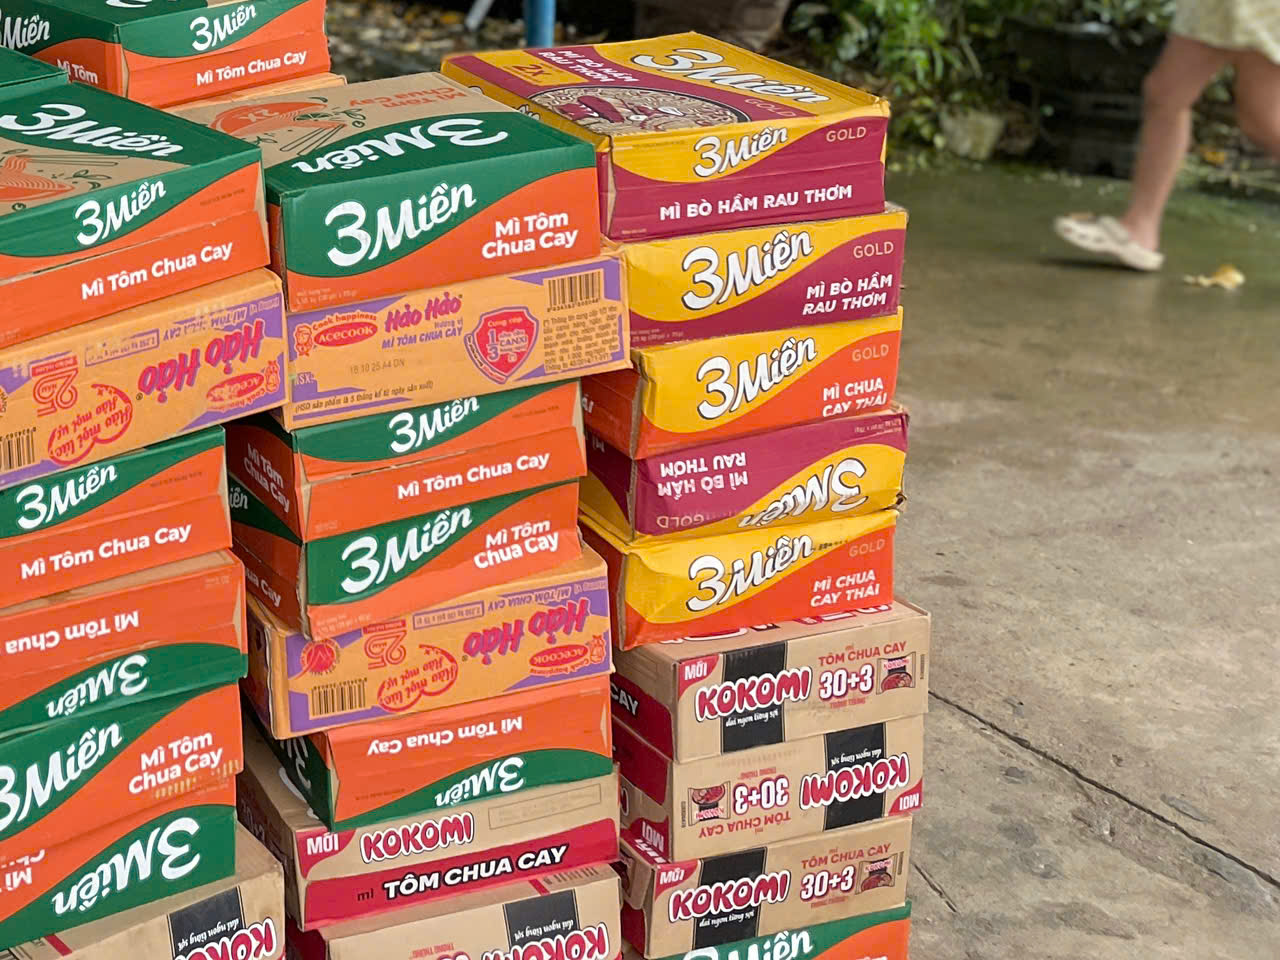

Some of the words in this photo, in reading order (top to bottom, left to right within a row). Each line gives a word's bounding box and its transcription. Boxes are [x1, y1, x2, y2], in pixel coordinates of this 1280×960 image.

[196, 70, 215, 86] Mì
[216, 66, 246, 82] Tôm
[248, 59, 281, 75] Chua
[283, 50, 308, 70] Cay
[825, 125, 867, 143] GOLD
[660, 201, 680, 221] MÌ
[686, 198, 713, 217] BÒ
[763, 190, 800, 210] RAU
[804, 184, 854, 205] THƠM
[494, 221, 522, 240] Mì
[524, 213, 570, 235] Tôm
[481, 234, 536, 260] Chua
[537, 228, 580, 253] Cay
[852, 242, 895, 259] GOLD
[81, 278, 105, 300] Mì
[107, 270, 149, 291] Tôm
[150, 252, 198, 278] Chua
[199, 242, 234, 263] Cay
[806, 282, 826, 300] MÌ
[829, 276, 854, 297] BÒ
[802, 299, 838, 316] RAU
[841, 292, 888, 311] THƠM
[852, 343, 890, 362] GOLD
[822, 382, 842, 401] MÌ
[844, 377, 885, 398] CHUA
[822, 401, 853, 419] CAY
[855, 393, 888, 412] THÁI
[659, 455, 709, 478] THƠM
[714, 451, 747, 471] RAU
[397, 481, 421, 500] Mì
[423, 473, 463, 493] Tôm
[466, 464, 513, 483] Chua
[516, 452, 551, 471] Cay
[701, 474, 725, 494] BÒ
[728, 471, 749, 492] MÌ
[484, 529, 508, 549] Mì
[510, 520, 551, 541] Tôm
[20, 559, 47, 581] Mì
[49, 548, 95, 572] Tôm
[98, 535, 151, 559] Chua
[153, 524, 193, 551] Cay
[473, 545, 524, 569] Chua
[525, 532, 559, 554] Cay
[810, 593, 843, 608] CAY
[845, 583, 881, 602] THÁI
[813, 576, 834, 593] MÌ
[835, 569, 876, 588] CHUA
[848, 646, 881, 662] CHUA
[883, 641, 907, 653] CAY
[696, 668, 812, 721] KOKOMI
[819, 663, 874, 699] 30+3
[140, 748, 168, 771] Mì
[169, 732, 213, 757] Tôm
[128, 764, 182, 796] Chua
[184, 747, 224, 774] Cay
[800, 753, 910, 810] KOKOMI
[361, 812, 474, 863] KOKOMI
[831, 849, 865, 864] CHUA
[866, 843, 892, 857] CAY
[357, 889, 375, 901] mì
[383, 873, 440, 900] TÔM
[444, 857, 513, 887] CHUA
[517, 845, 568, 870] CAY
[800, 865, 856, 902] 30+3
[669, 871, 791, 923] KOKOMI
